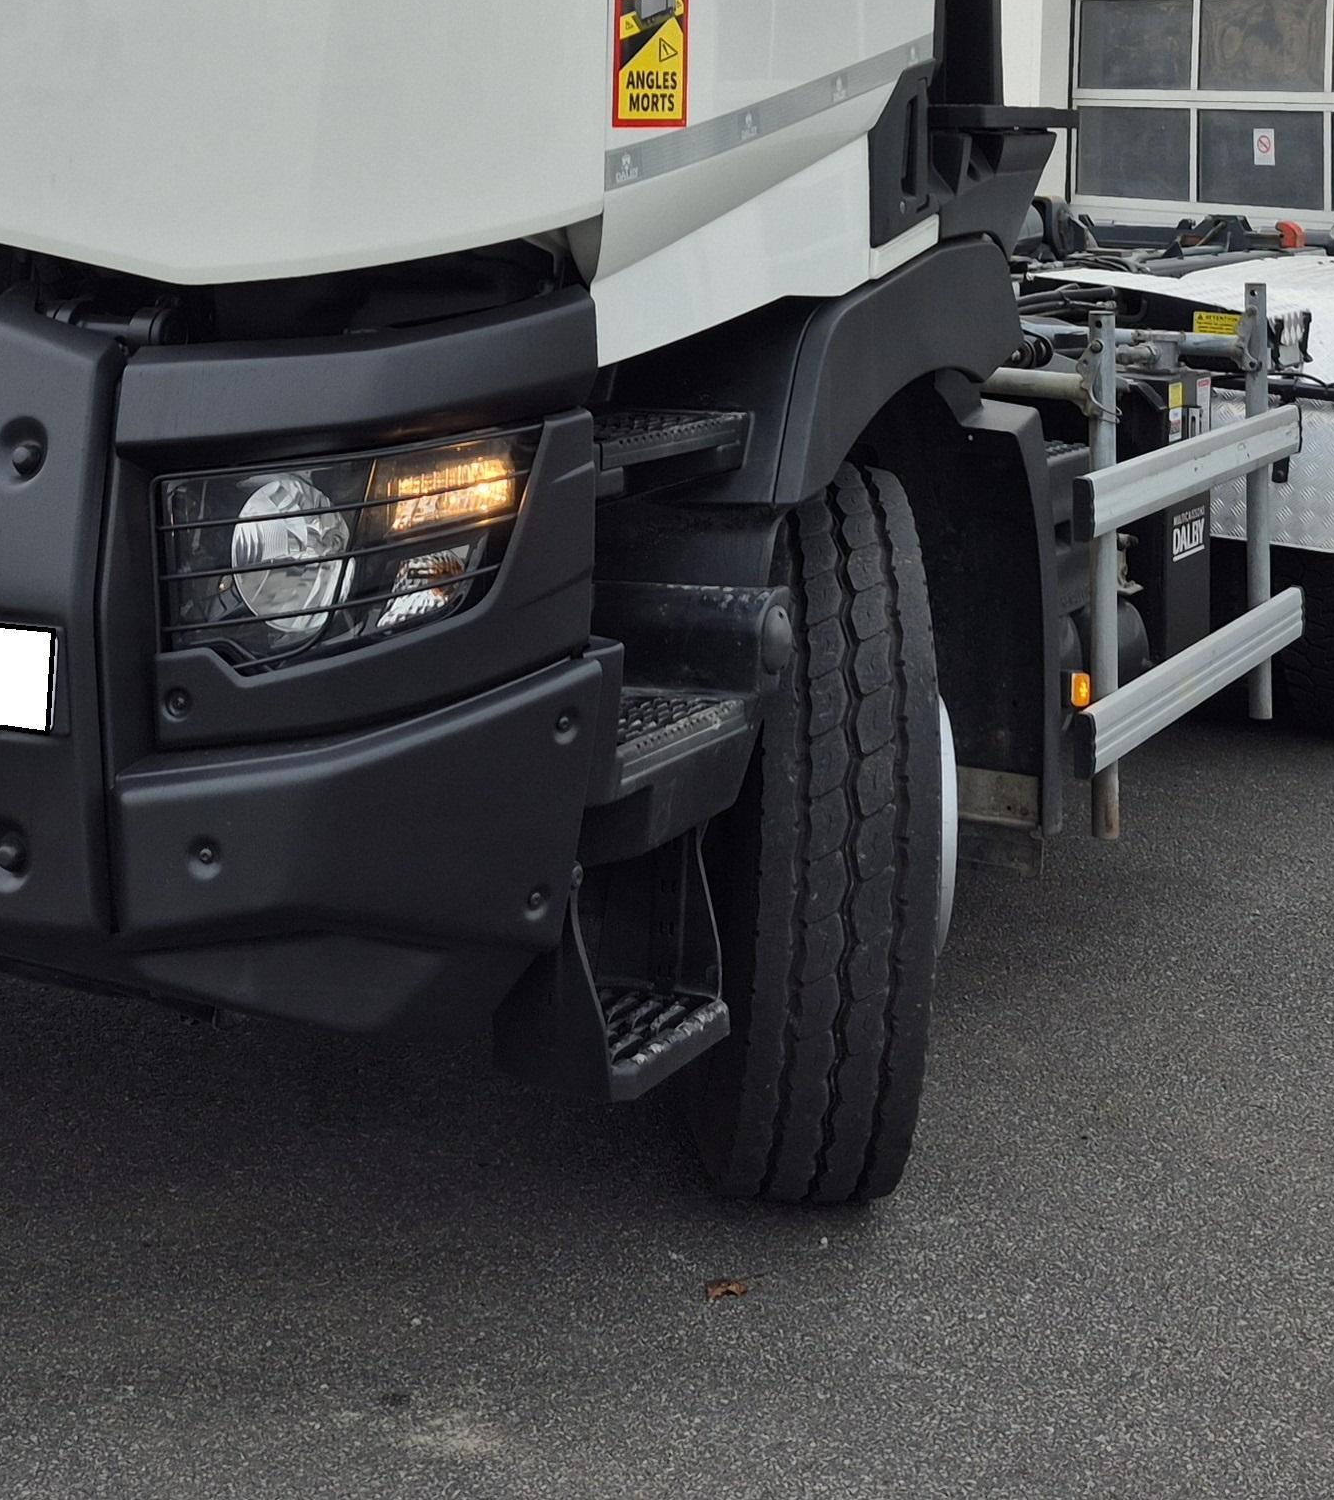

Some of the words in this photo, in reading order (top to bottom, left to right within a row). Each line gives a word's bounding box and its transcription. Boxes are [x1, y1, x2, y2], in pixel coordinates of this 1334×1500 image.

[626, 71, 678, 90] ANGLES
[629, 93, 675, 112] MORTS
[1172, 517, 1205, 555] DALBY
